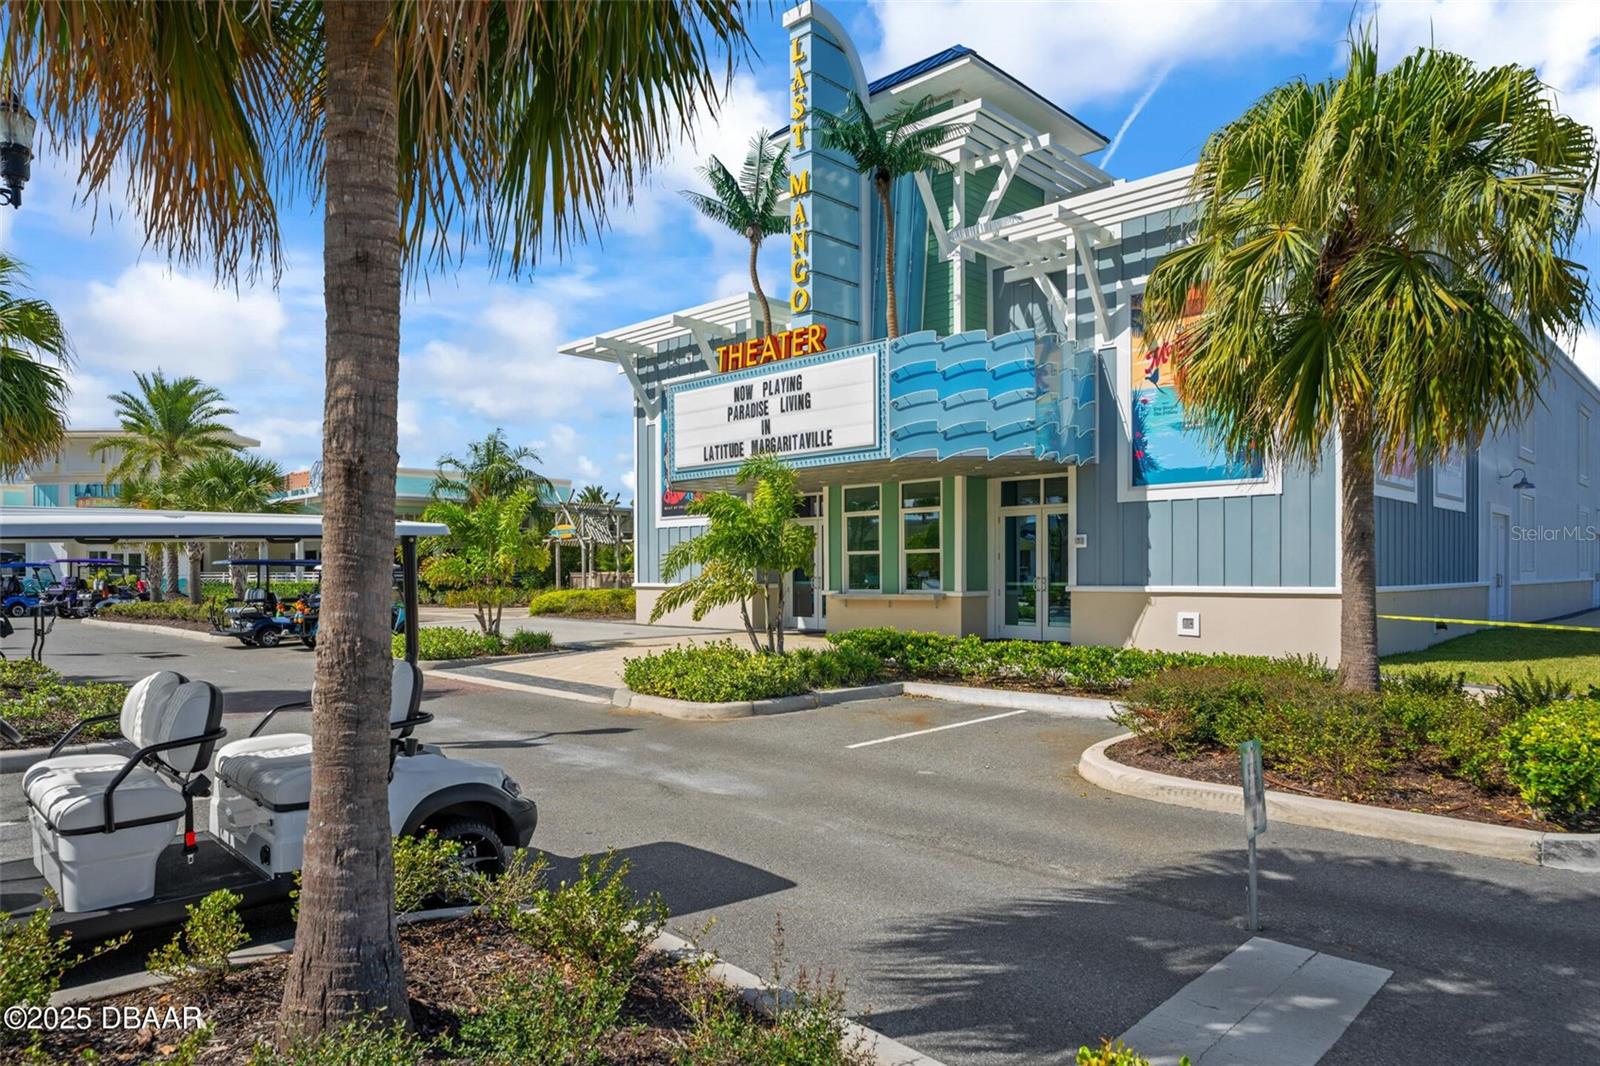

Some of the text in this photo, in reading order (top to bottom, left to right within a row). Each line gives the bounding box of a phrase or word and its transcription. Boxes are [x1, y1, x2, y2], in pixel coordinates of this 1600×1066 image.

[789, 37, 810, 313] LAST MANGO
[716, 324, 827, 373] THEATER
[734, 374, 802, 403] NOW PLAYING
[727, 392, 811, 422] PARADISE LIVING
[761, 419, 771, 435] IN
[703, 430, 833, 462] LATITUDE MARGARITAVILLE
